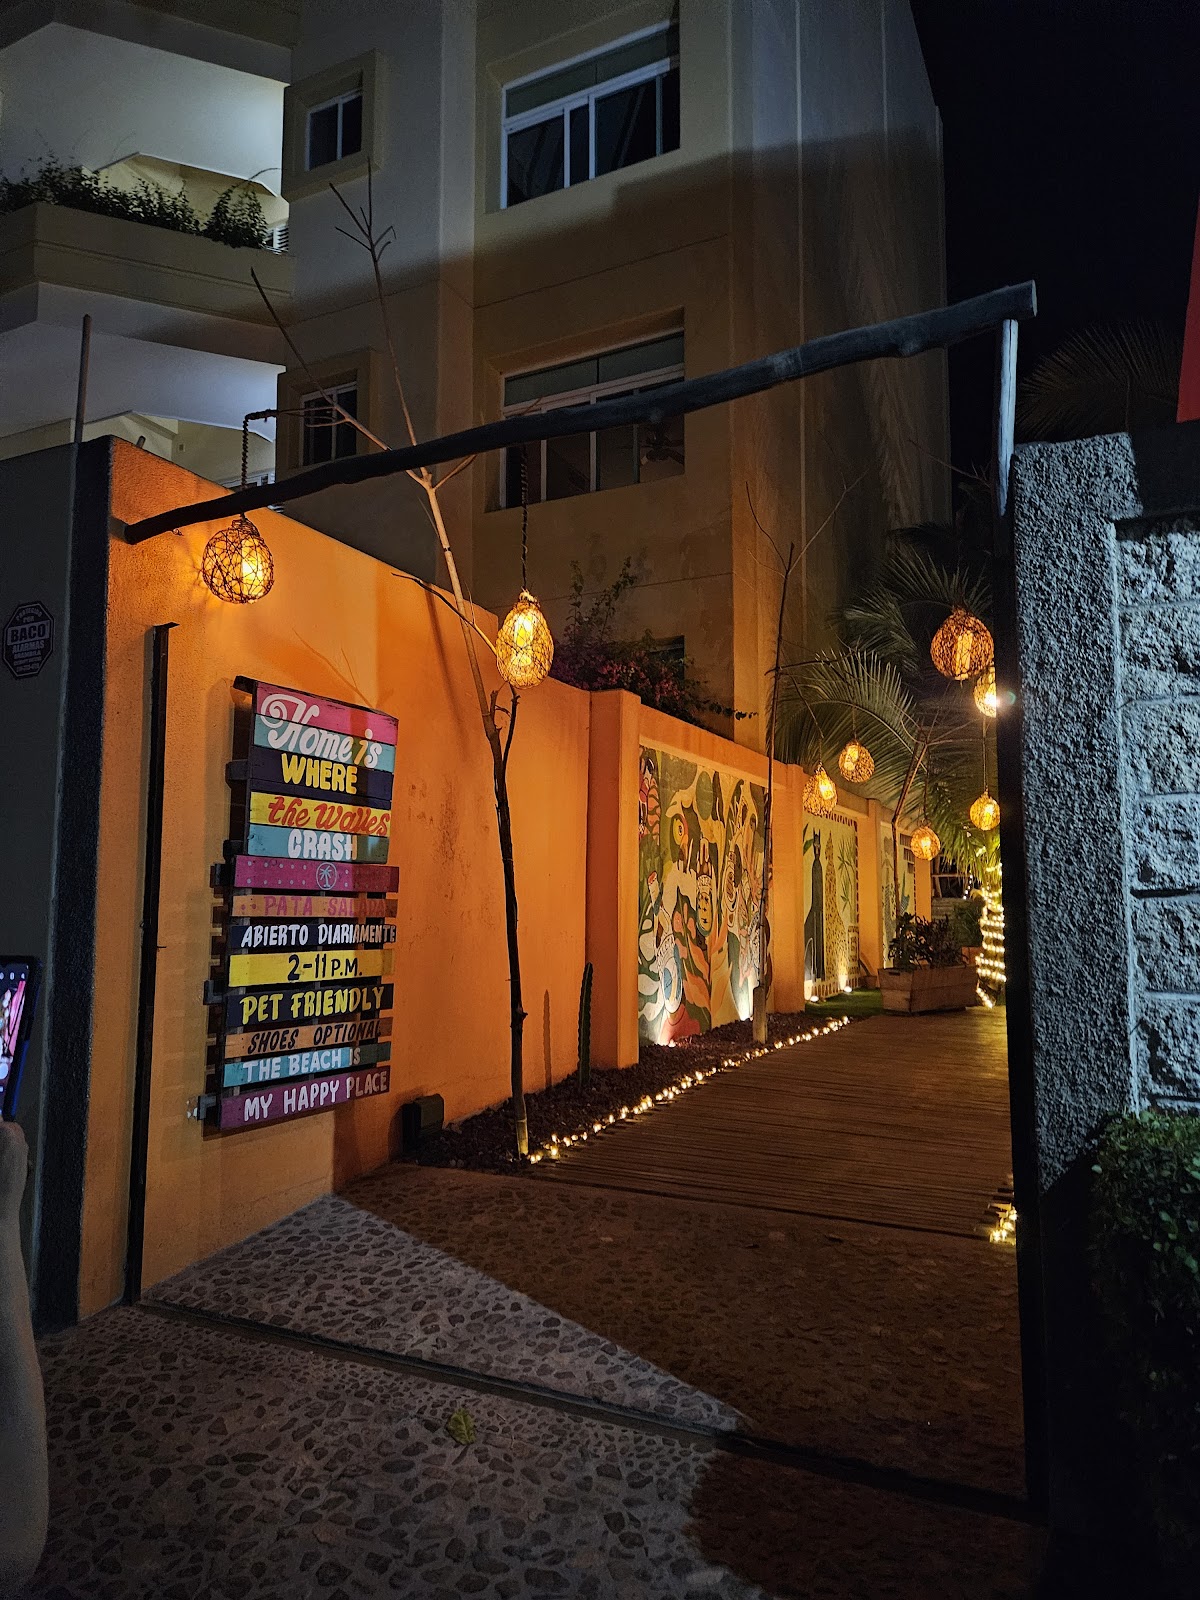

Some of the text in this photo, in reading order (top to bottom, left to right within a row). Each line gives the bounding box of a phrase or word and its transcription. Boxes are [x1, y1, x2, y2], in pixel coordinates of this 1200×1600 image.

[11, 623, 46, 643] BACO
[12, 639, 45, 654] ALARMAS
[260, 693, 383, 768] Home is
[281, 752, 358, 795] WHERE
[268, 796, 311, 827] the
[287, 828, 358, 861] CRASH
[263, 895, 313, 917] PATA
[240, 923, 396, 948] ABIERTO DIARIAMENTE
[239, 986, 385, 1025] PET FRIENDLY
[247, 1019, 382, 1055] SHOES OPTIONAL
[242, 1047, 361, 1083] THE BEACH IS
[243, 1070, 388, 1122] MY HAPPY PLACE
